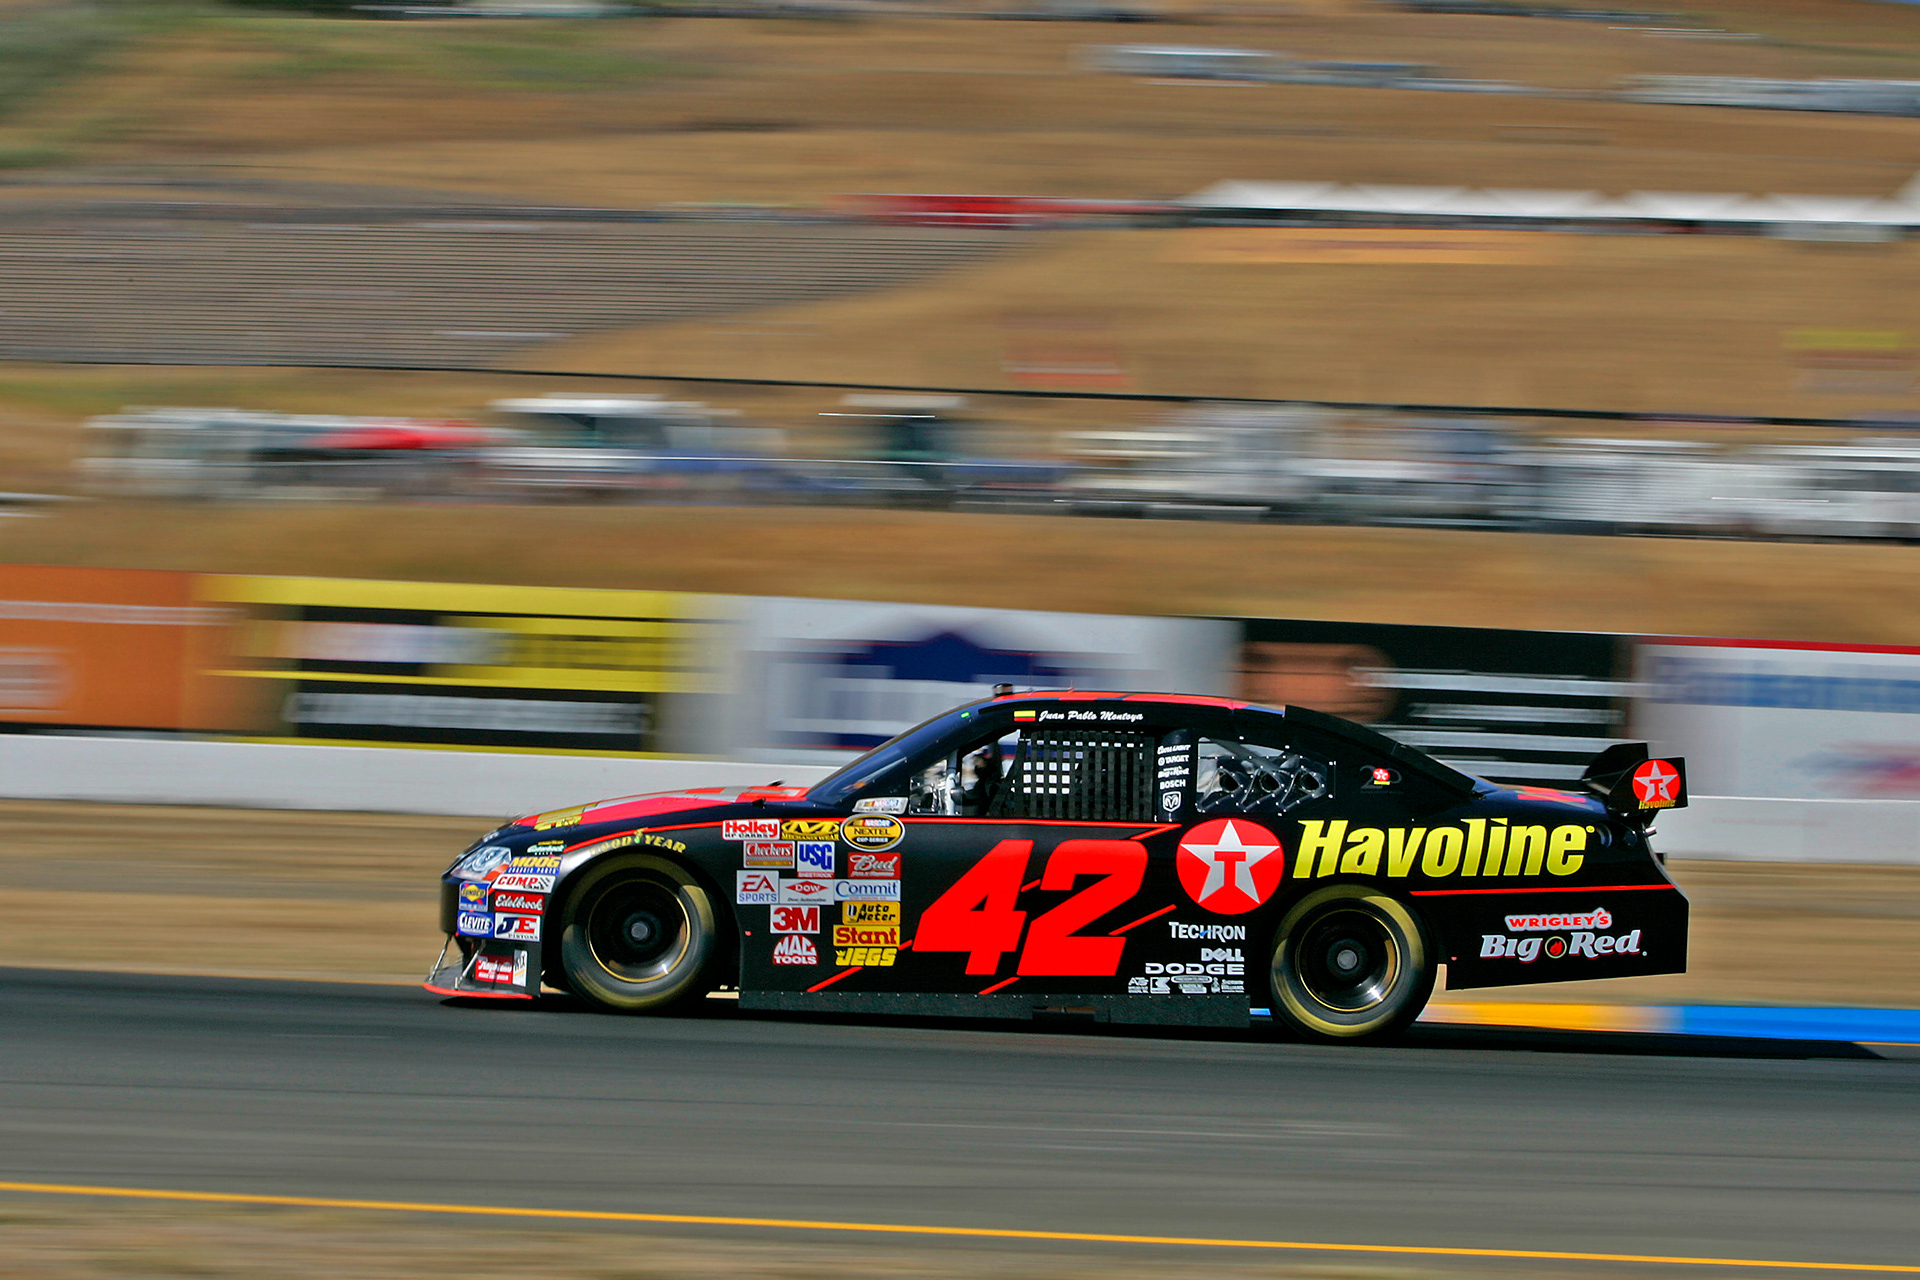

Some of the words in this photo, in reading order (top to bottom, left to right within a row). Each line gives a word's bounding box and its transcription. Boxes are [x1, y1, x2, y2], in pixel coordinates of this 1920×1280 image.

[1039, 710, 1065, 722] Juan
[1067, 710, 1097, 720] Pablo
[1100, 710, 1144, 723] Montoya
[1160, 779, 1186, 790] BOSCH
[1638, 799, 1677, 810] Havoline
[725, 820, 778, 838] Holley
[853, 827, 890, 836] NEXTEL
[746, 842, 792, 856] Checkers
[1293, 817, 1588, 879] Havoline
[509, 856, 562, 868] MOOG
[798, 843, 833, 871] USG
[849, 854, 899, 871] Bud
[497, 876, 539, 886] COMP
[741, 874, 776, 892] EA
[835, 880, 898, 898] Commit
[495, 893, 543, 911] Edelbrock
[738, 892, 777, 902] SPORTS
[859, 903, 889, 913] Auto
[912, 839, 1148, 976] 42
[496, 917, 538, 935] JE
[772, 906, 818, 932] 3M
[856, 912, 896, 923] Meter
[1509, 911, 1611, 928] WRIGLEY'S
[836, 927, 897, 944] Stant
[1168, 921, 1246, 943] TECHRON
[773, 935, 817, 956] MAC
[1480, 934, 1544, 963] Big
[1568, 929, 1642, 960] Red
[773, 955, 817, 965] TOOLS
[835, 947, 898, 966] JEGS
[1200, 947, 1245, 962] DELL
[1145, 962, 1245, 975] DODGE
